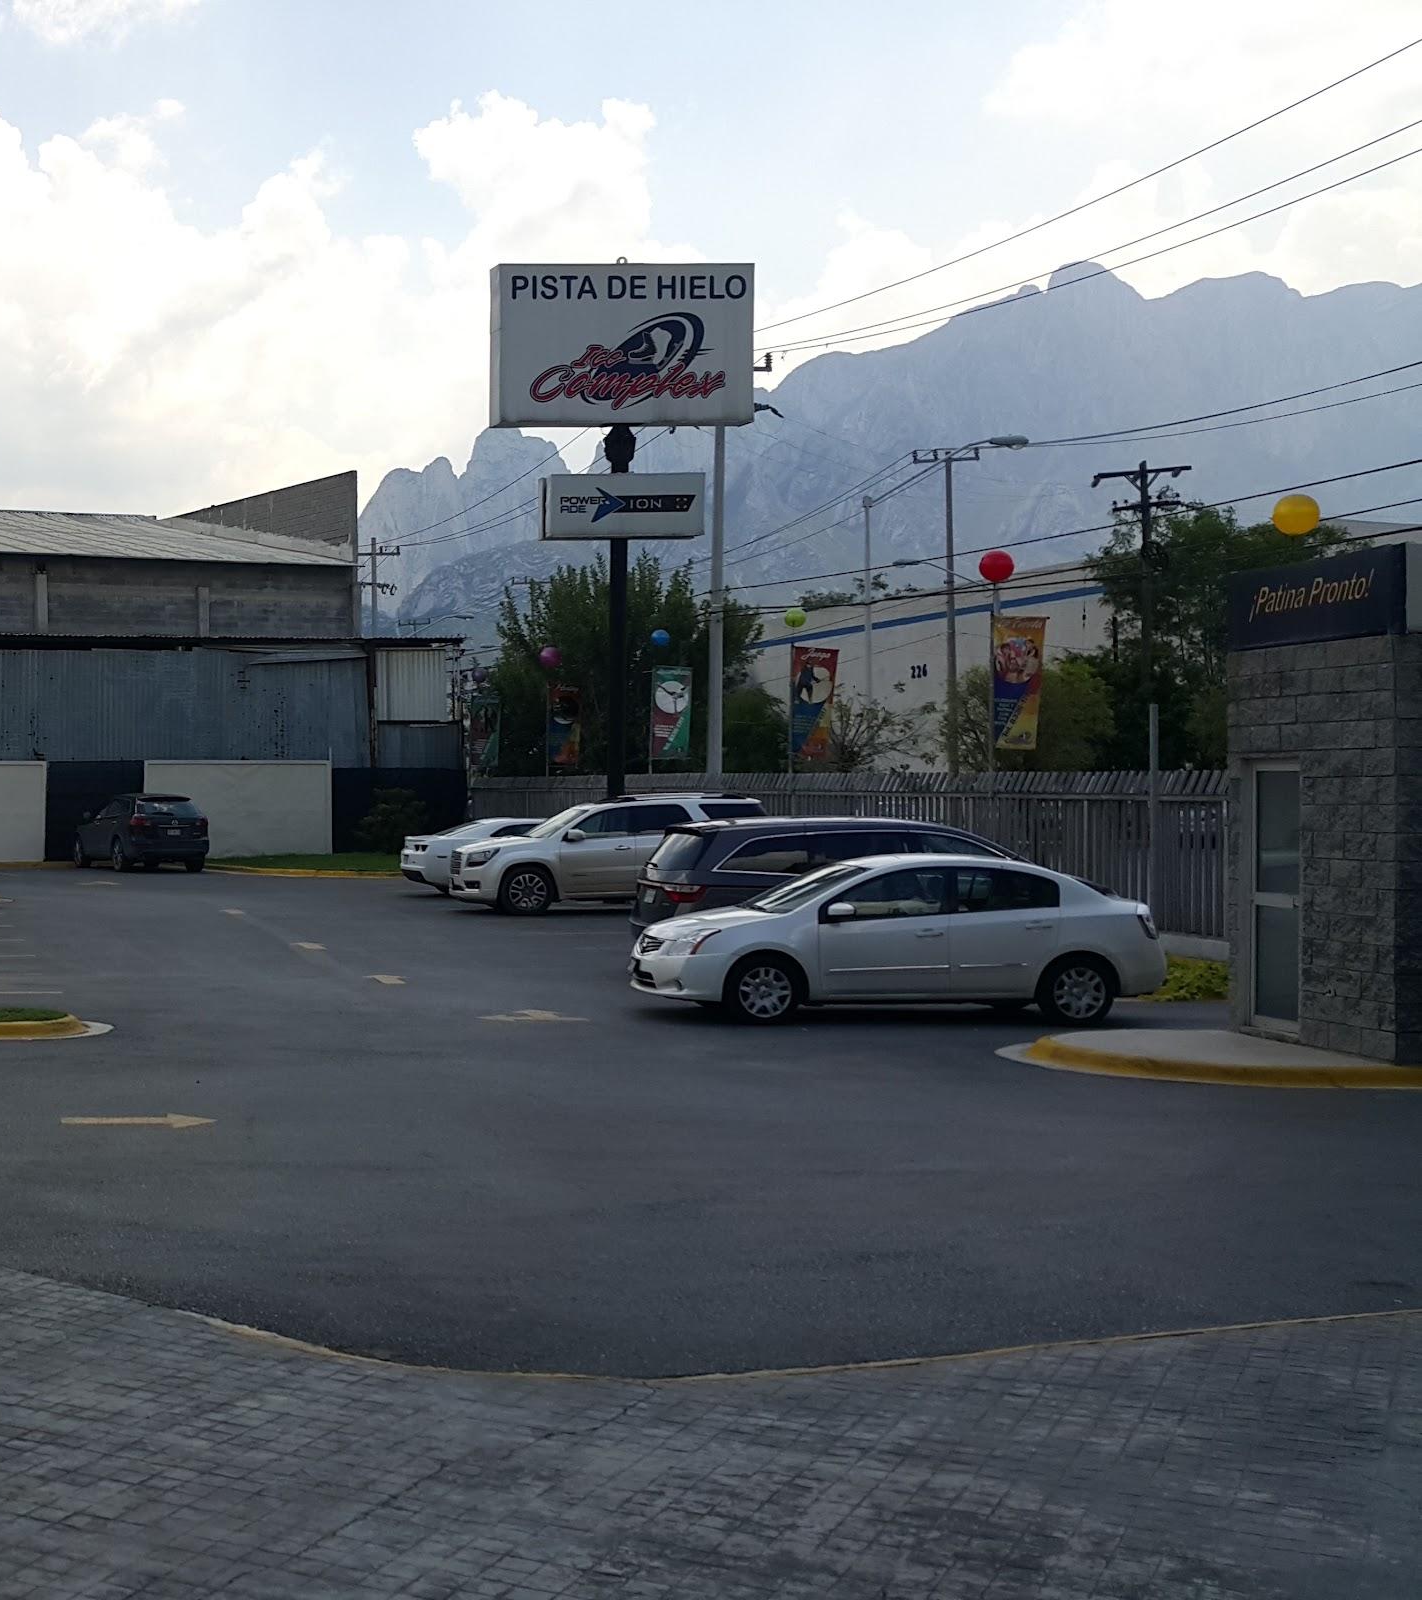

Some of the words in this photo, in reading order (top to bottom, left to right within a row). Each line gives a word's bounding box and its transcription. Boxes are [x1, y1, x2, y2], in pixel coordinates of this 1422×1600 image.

[511, 275, 598, 300] PISTA
[607, 275, 647, 299] DE
[657, 274, 747, 300] HIELO
[570, 344, 627, 369] Ice
[529, 362, 727, 410] Complex
[629, 498, 662, 509] ION
[1248, 584, 1306, 623] ¡Patina
[1308, 568, 1375, 606] Pronto!
[910, 663, 928, 679] 226
